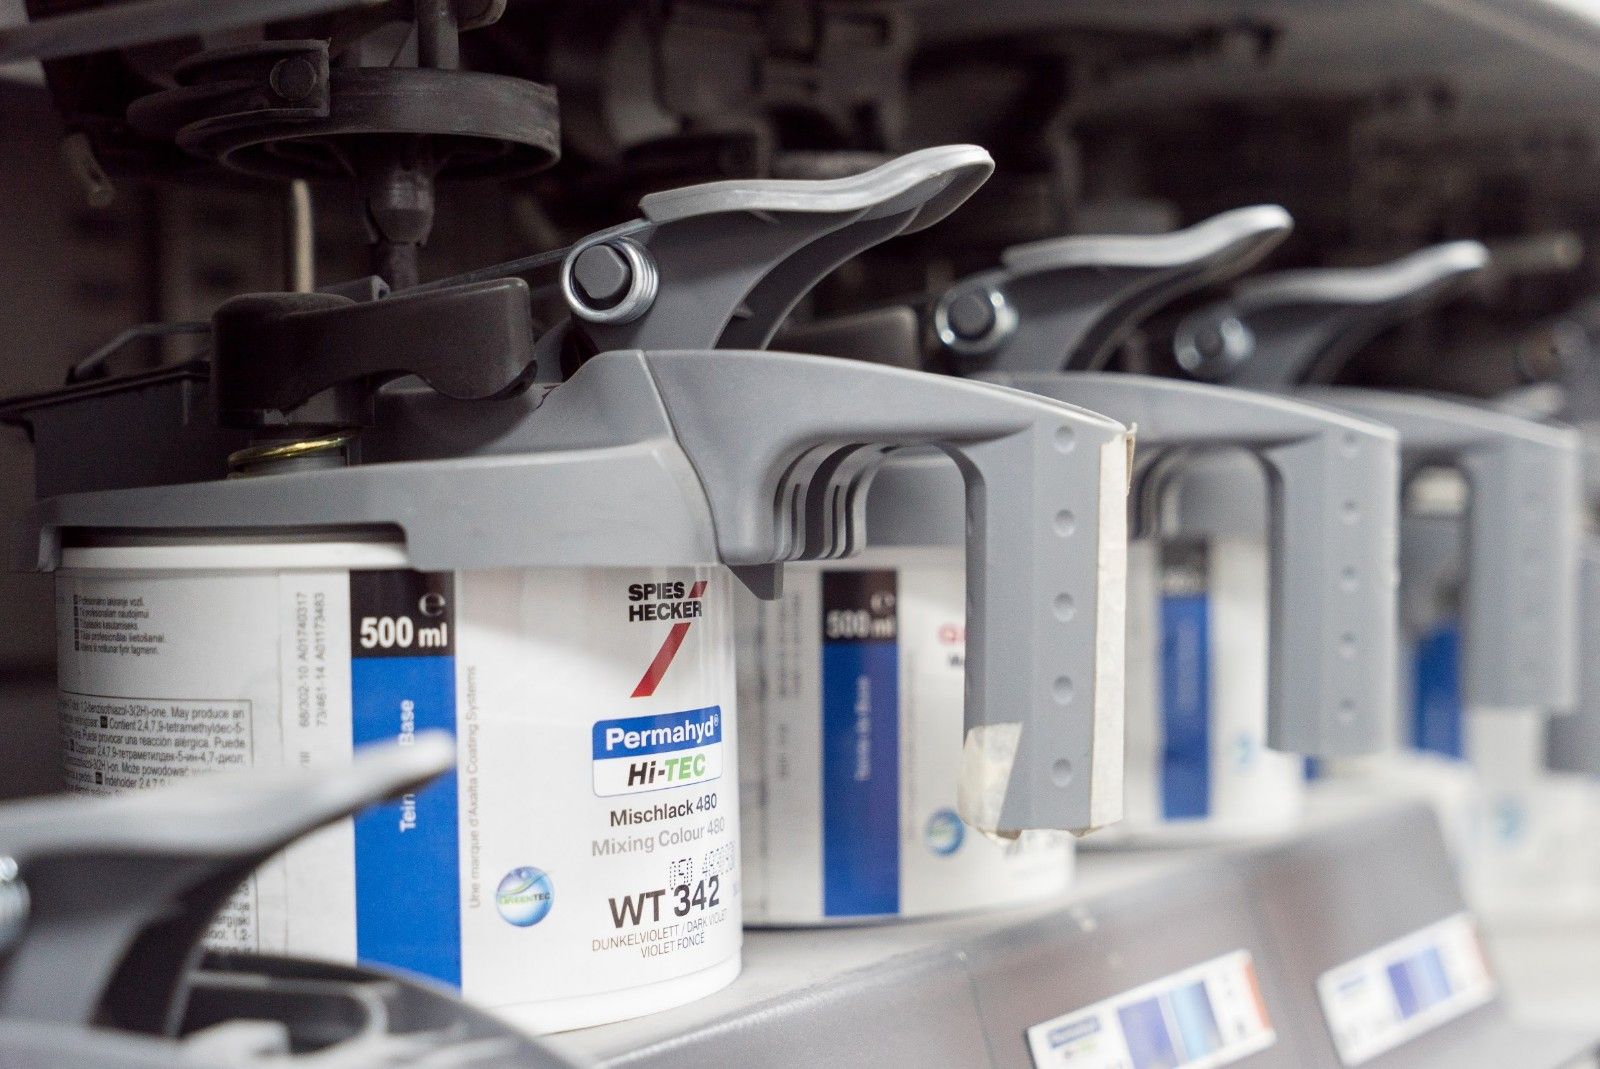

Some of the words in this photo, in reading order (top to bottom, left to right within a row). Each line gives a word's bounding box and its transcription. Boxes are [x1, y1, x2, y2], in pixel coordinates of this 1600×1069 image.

[628, 581, 685, 601] SPIES
[629, 600, 703, 622] HECKER
[360, 616, 414, 648] 500
[418, 622, 448, 648] ml
[465, 665, 478, 722] Systems
[171, 707, 189, 720] May
[191, 708, 229, 720] produce
[466, 724, 479, 775] Coating
[627, 753, 706, 787] Hi-TEC
[610, 799, 694, 827] Mischlack
[695, 793, 717, 812] 480
[592, 835, 655, 857] Mixing
[658, 827, 705, 847] Colour
[707, 816, 725, 835] 480
[469, 830, 481, 880] marque
[469, 883, 480, 909] Une
[608, 889, 666, 929] WT
[673, 874, 720, 917] 342
[592, 924, 680, 951] DUNKELVIOLETT
[687, 915, 708, 933] DARK
[640, 940, 677, 959] VIOLET
